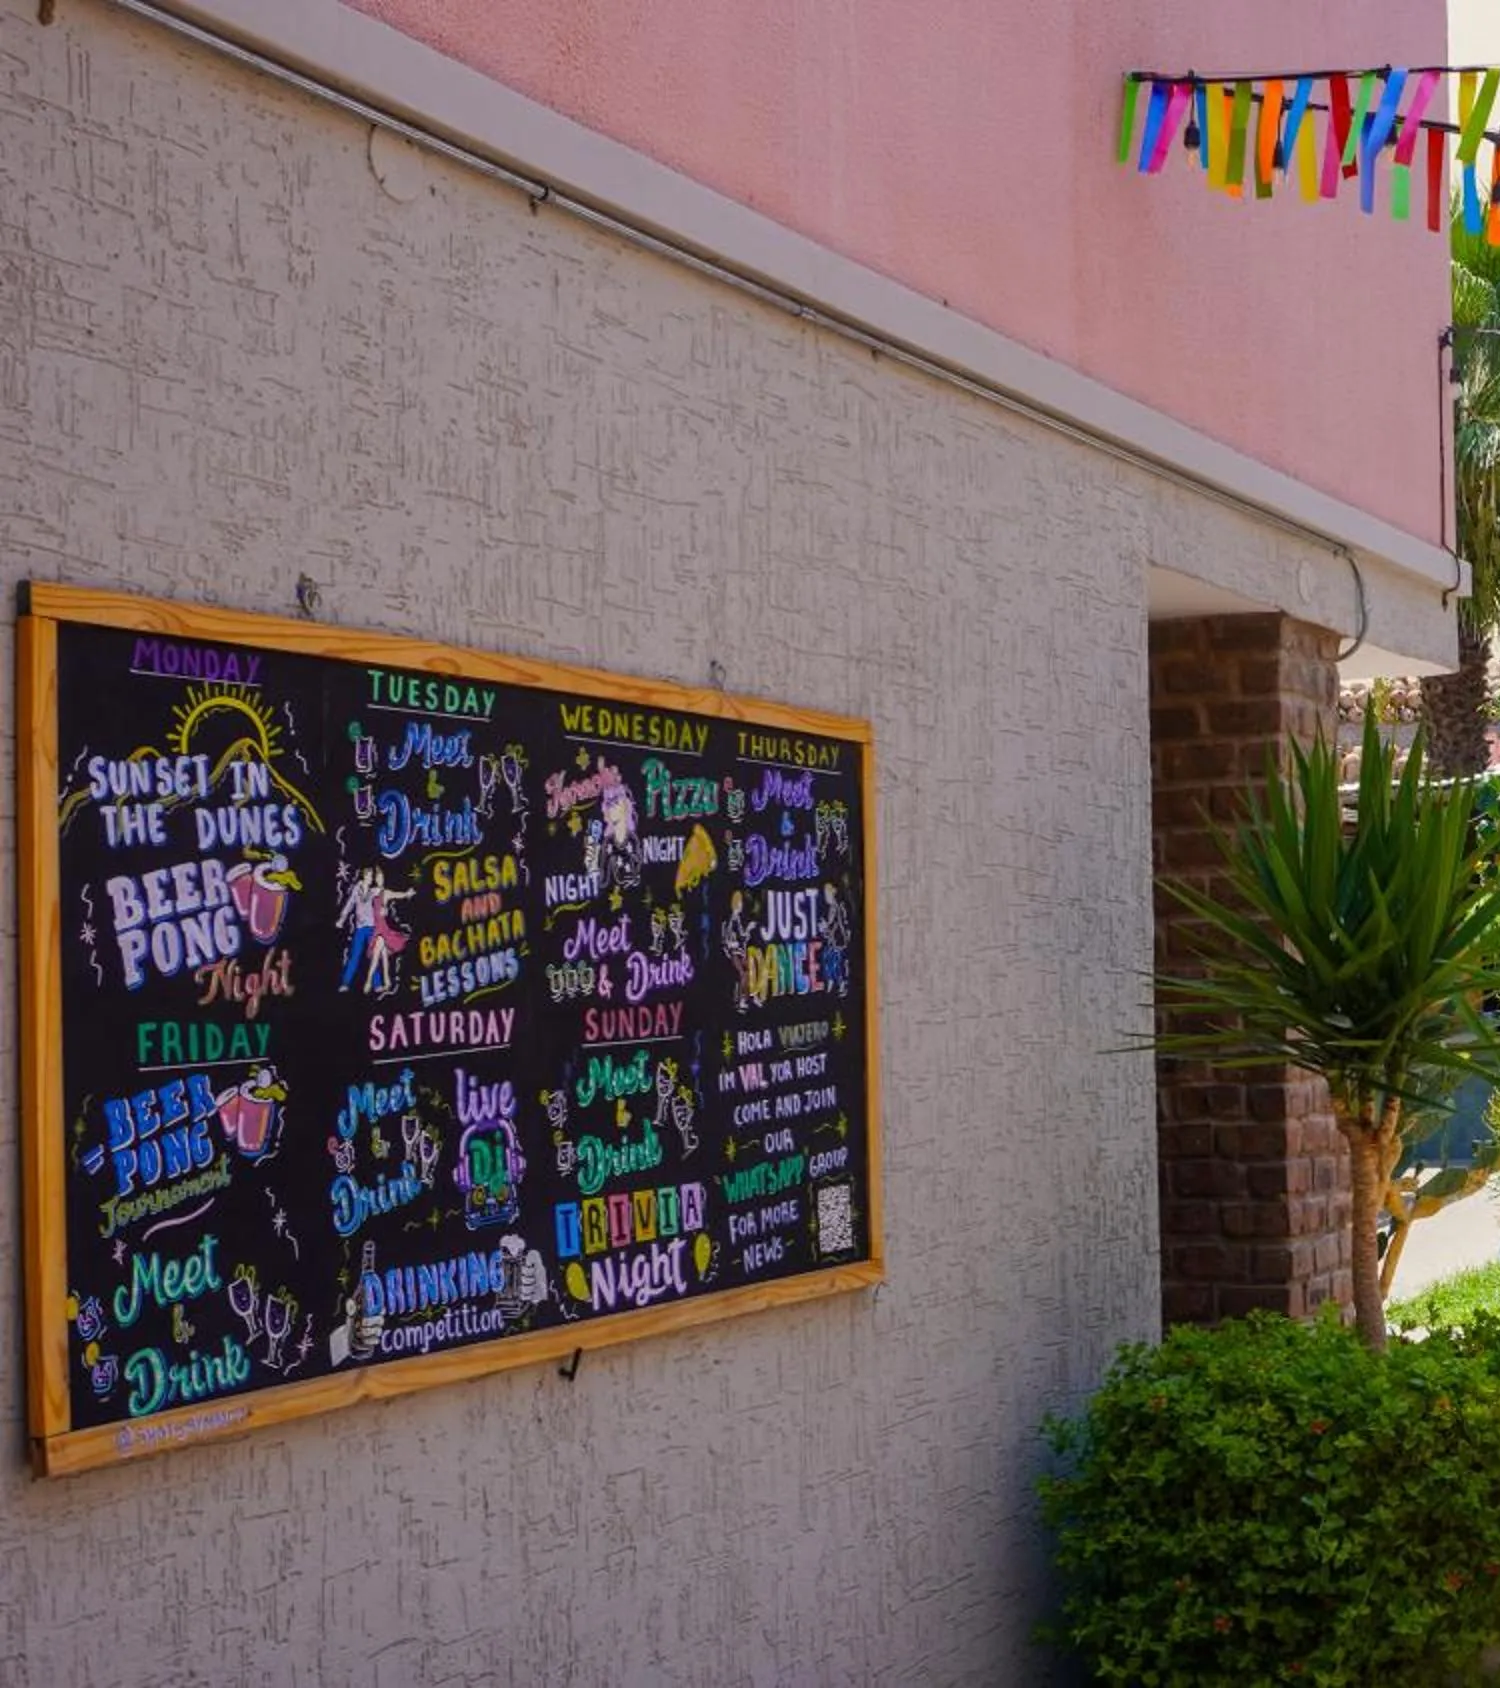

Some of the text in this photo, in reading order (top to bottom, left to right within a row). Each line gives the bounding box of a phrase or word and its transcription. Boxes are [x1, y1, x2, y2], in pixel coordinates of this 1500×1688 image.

[132, 637, 264, 684] MONDAY
[367, 669, 496, 717] TUESDAY
[388, 723, 475, 772] Meet
[560, 703, 709, 751] WEDNESDAY
[736, 732, 841, 768] THURSDAY
[87, 754, 270, 802] SUNSET IN
[751, 769, 817, 812] Meet
[101, 802, 300, 850] THE DUNES
[376, 788, 485, 860] Drink
[642, 834, 687, 866] NIGHT
[743, 833, 821, 888] Drink
[107, 858, 231, 933] BEER
[432, 854, 519, 903] SALSA
[544, 871, 601, 906] NIGHT
[460, 893, 503, 925] AND
[760, 888, 818, 942] JUST
[117, 906, 240, 992] PONG
[419, 909, 527, 970] BACHATA
[563, 913, 633, 961] Meet
[194, 945, 296, 1019] Night
[419, 947, 521, 1008] LESSONS
[597, 949, 695, 1002] & Drink
[747, 939, 824, 999] DANCE
[136, 1022, 272, 1066] FRIDAY
[369, 1008, 516, 1052] SATURDAY
[583, 1002, 684, 1042] SUNDAY
[737, 1028, 772, 1055] HOLA
[576, 1049, 653, 1108] Meet
[738, 1062, 769, 1093] VAL
[795, 1053, 827, 1079] HOST
[103, 1073, 218, 1153] BEER
[337, 1067, 417, 1138] Meet
[733, 1085, 837, 1126] COME AND JOIN
[110, 1119, 215, 1197] PONG
[576, 1118, 664, 1195] Drink
[764, 1127, 795, 1153] OUR
[809, 1146, 849, 1178] GROUP
[331, 1160, 425, 1237] Drink
[557, 1184, 701, 1258] TRIVIA
[728, 1199, 800, 1244] FOR MORE
[112, 1233, 224, 1326] Meet
[591, 1238, 690, 1312] Night
[742, 1238, 784, 1274] NEWS
[363, 1250, 506, 1319] DRINKING
[380, 1309, 505, 1354] competition
[122, 1334, 252, 1416] Drink
